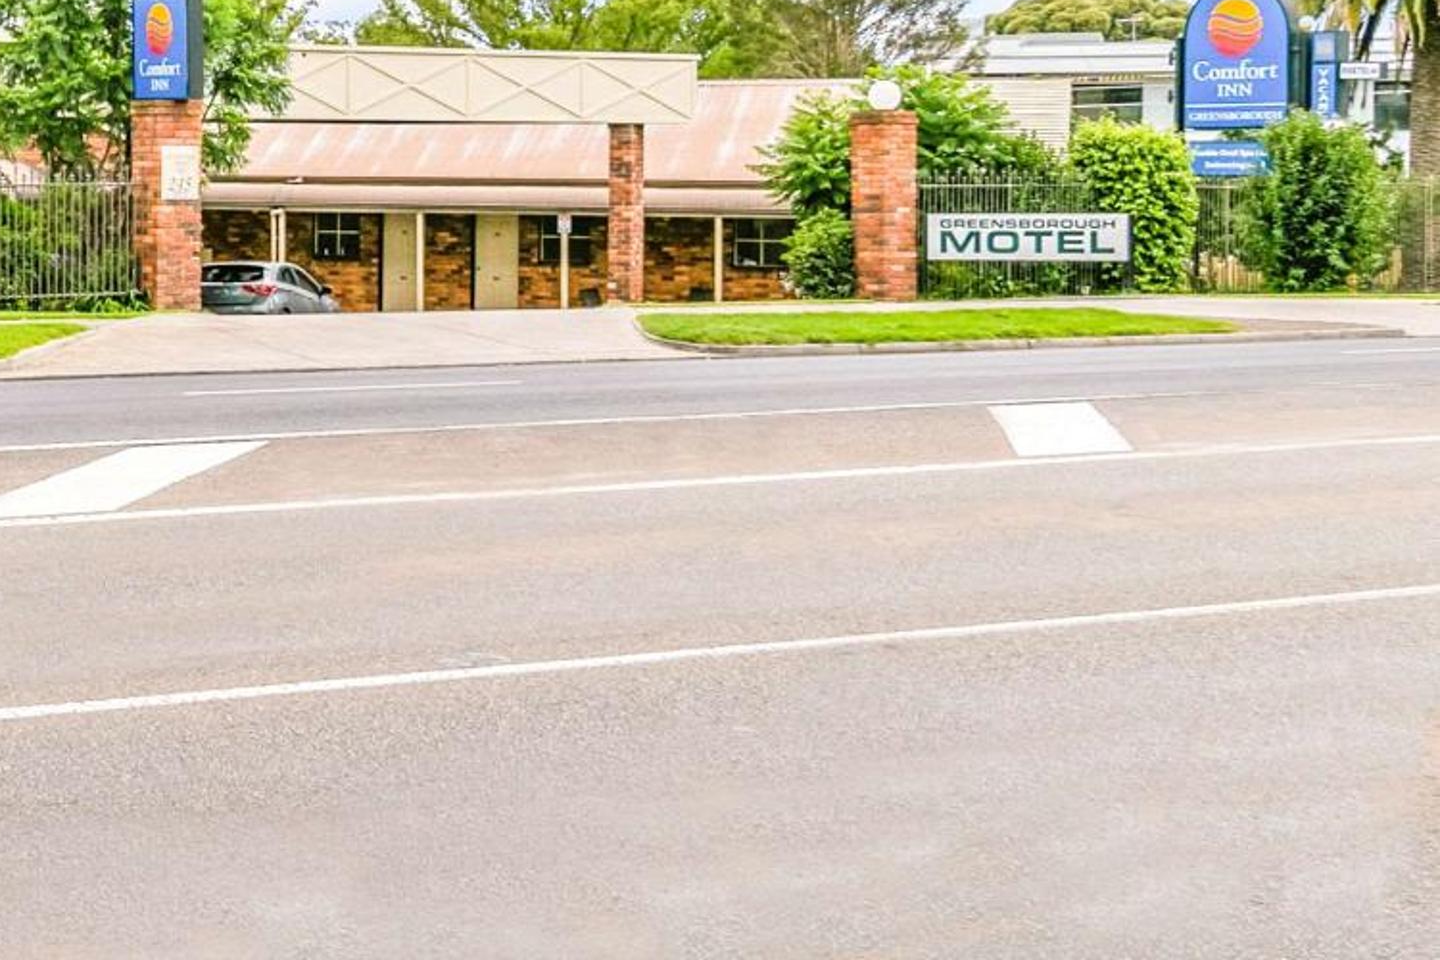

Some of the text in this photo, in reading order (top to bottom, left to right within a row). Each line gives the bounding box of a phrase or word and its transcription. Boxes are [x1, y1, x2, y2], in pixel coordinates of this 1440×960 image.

[139, 58, 181, 76] Comfort
[1192, 59, 1279, 81] Comfort
[150, 78, 170, 91] INN
[1216, 82, 1253, 98] INN
[939, 218, 1116, 230] GREENSBOROUGH
[939, 231, 1115, 254] MOTEL
